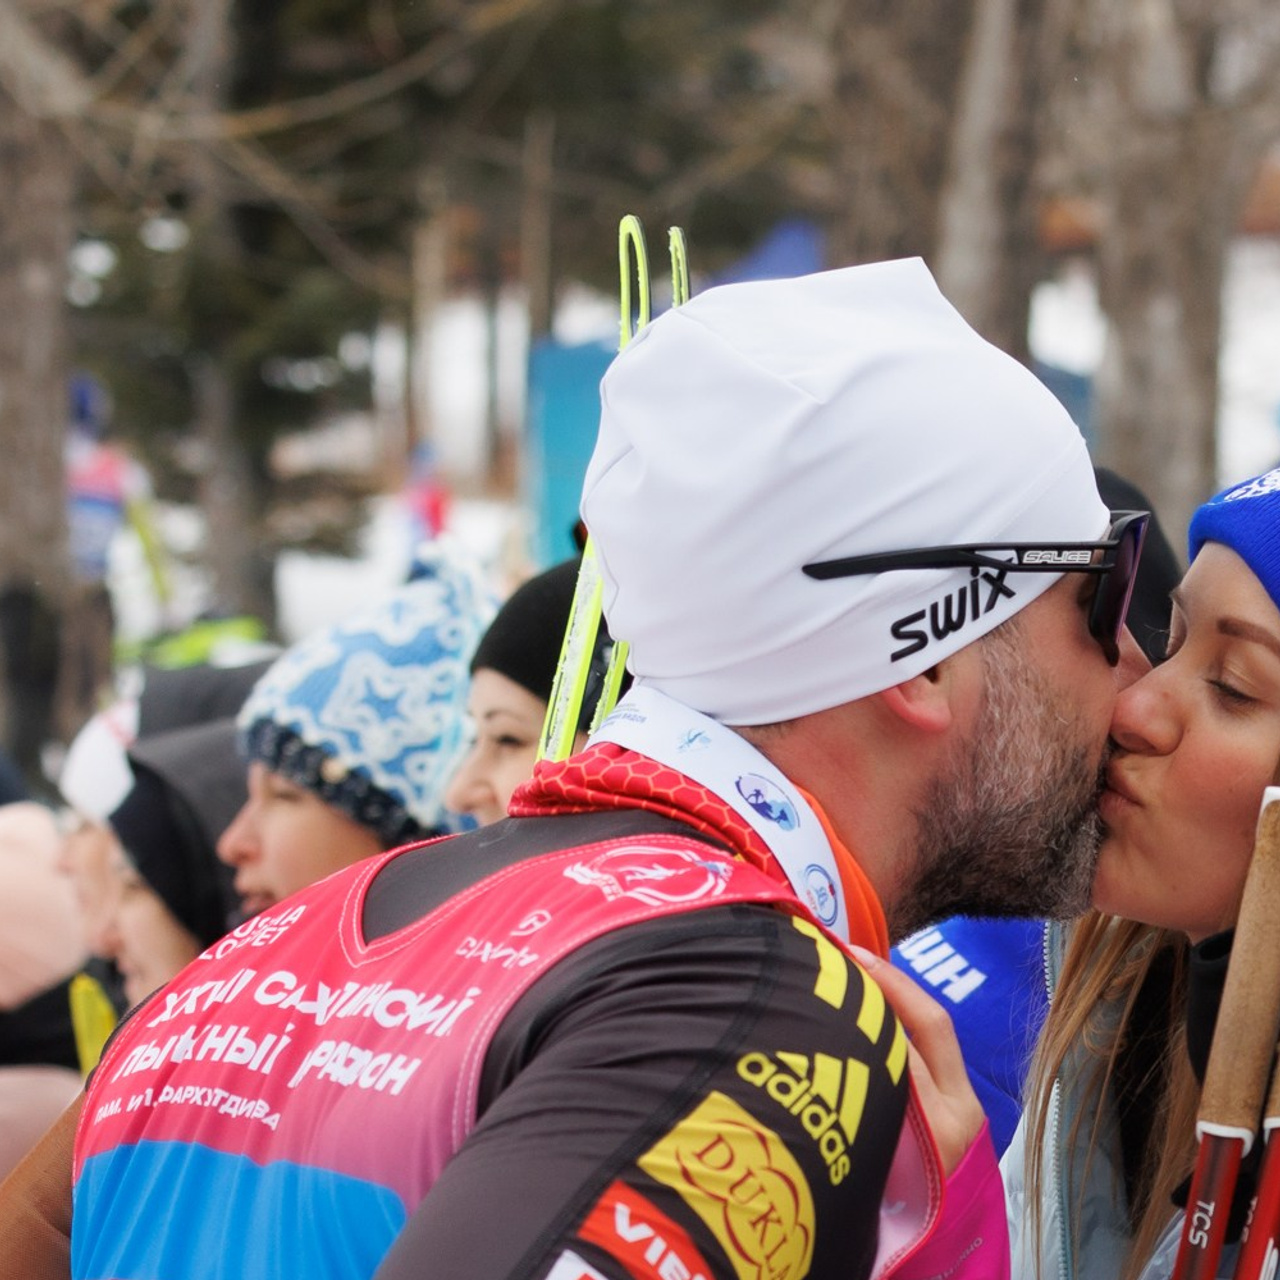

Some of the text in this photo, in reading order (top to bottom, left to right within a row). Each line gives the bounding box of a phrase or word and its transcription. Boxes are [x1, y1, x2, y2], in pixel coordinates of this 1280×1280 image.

[1022, 551, 1092, 564] SALICE
[736, 1051, 851, 1186] adidas
[1189, 1200, 1215, 1249] TCS
